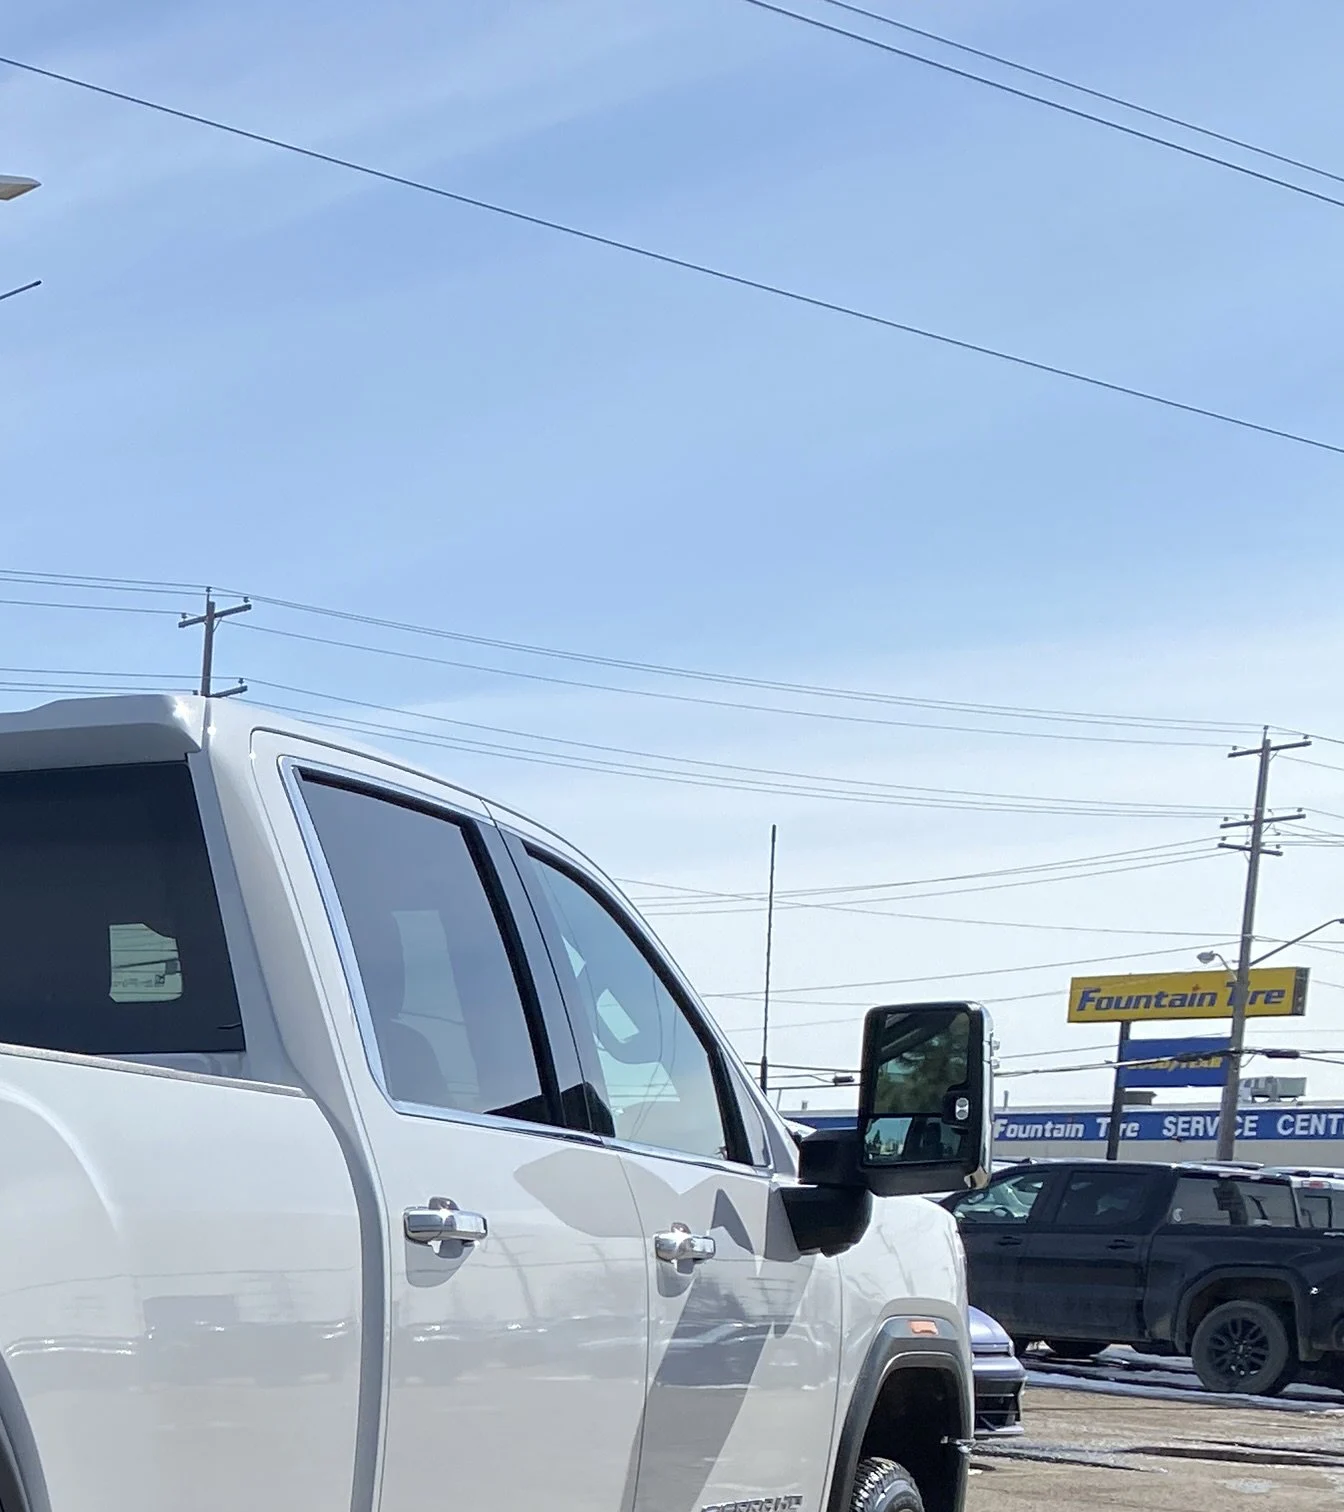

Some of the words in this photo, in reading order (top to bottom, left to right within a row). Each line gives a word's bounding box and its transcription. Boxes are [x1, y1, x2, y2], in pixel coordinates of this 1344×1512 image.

[1076, 984, 1217, 1012] Fountain
[1225, 981, 1286, 1006] Tre
[993, 1117, 1085, 1139] Fountain
[1096, 1116, 1140, 1138] Tre
[1162, 1115, 1259, 1138] SERVE
[1277, 1113, 1344, 1136] CENT
